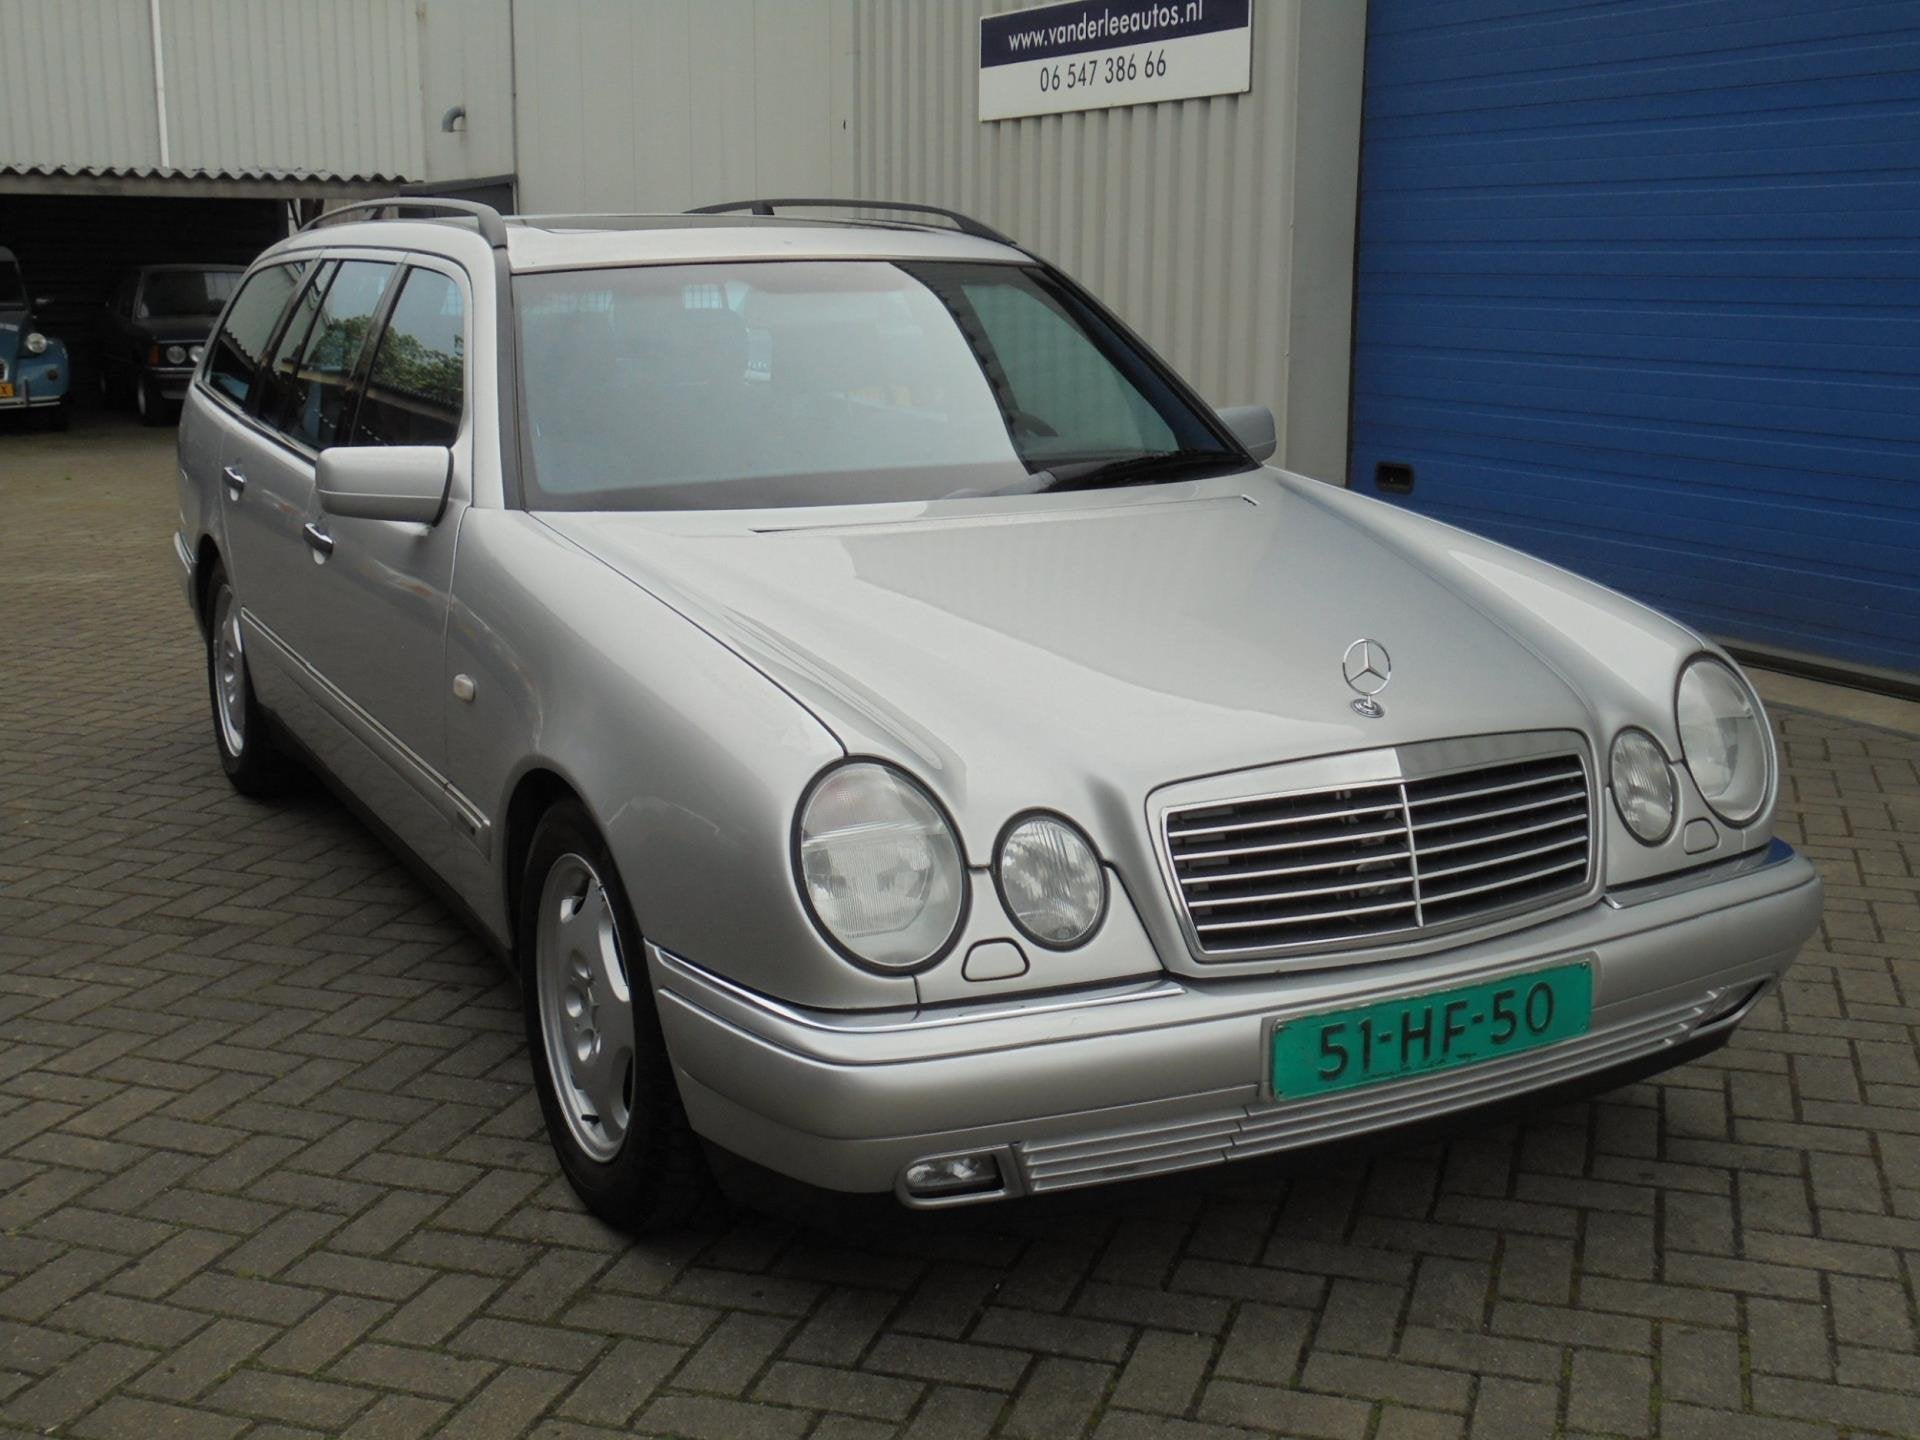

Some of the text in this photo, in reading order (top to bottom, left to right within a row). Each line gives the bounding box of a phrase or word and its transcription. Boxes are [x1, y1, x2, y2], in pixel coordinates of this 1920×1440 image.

[1008, 0, 1203, 51] www.vanderleeautos.nl
[1040, 49, 1167, 92] 06 547 386 66
[1318, 981, 1555, 1081] 51-HF-50
